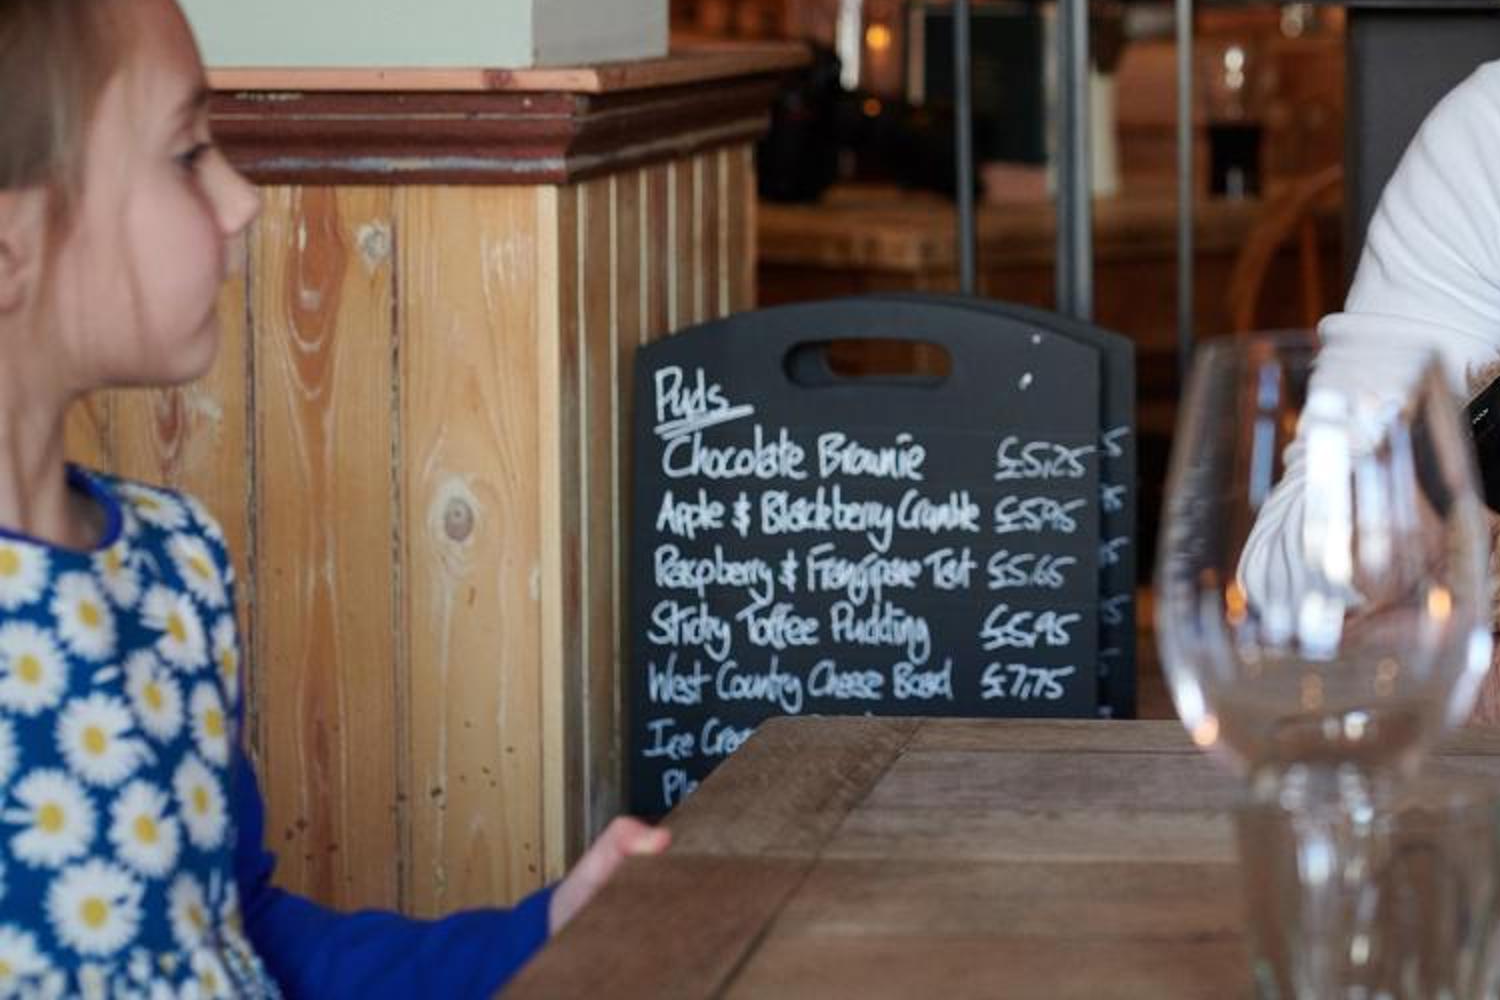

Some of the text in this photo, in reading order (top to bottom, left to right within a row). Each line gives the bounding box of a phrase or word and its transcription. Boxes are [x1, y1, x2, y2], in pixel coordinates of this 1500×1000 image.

[655, 366, 730, 424] Puds
[662, 424, 807, 480] Chocolate
[816, 432, 926, 481] Brownie
[656, 489, 726, 540] Apple
[761, 484, 894, 552] Blackberry
[654, 543, 775, 605] Raspberry
[647, 599, 732, 662] Sticky
[735, 601, 821, 650] Toffee
[830, 599, 932, 665] Pudding
[648, 651, 712, 705] West
[715, 653, 803, 715] Country
[806, 659, 885, 701] Cheese
[642, 717, 696, 760] Ice
